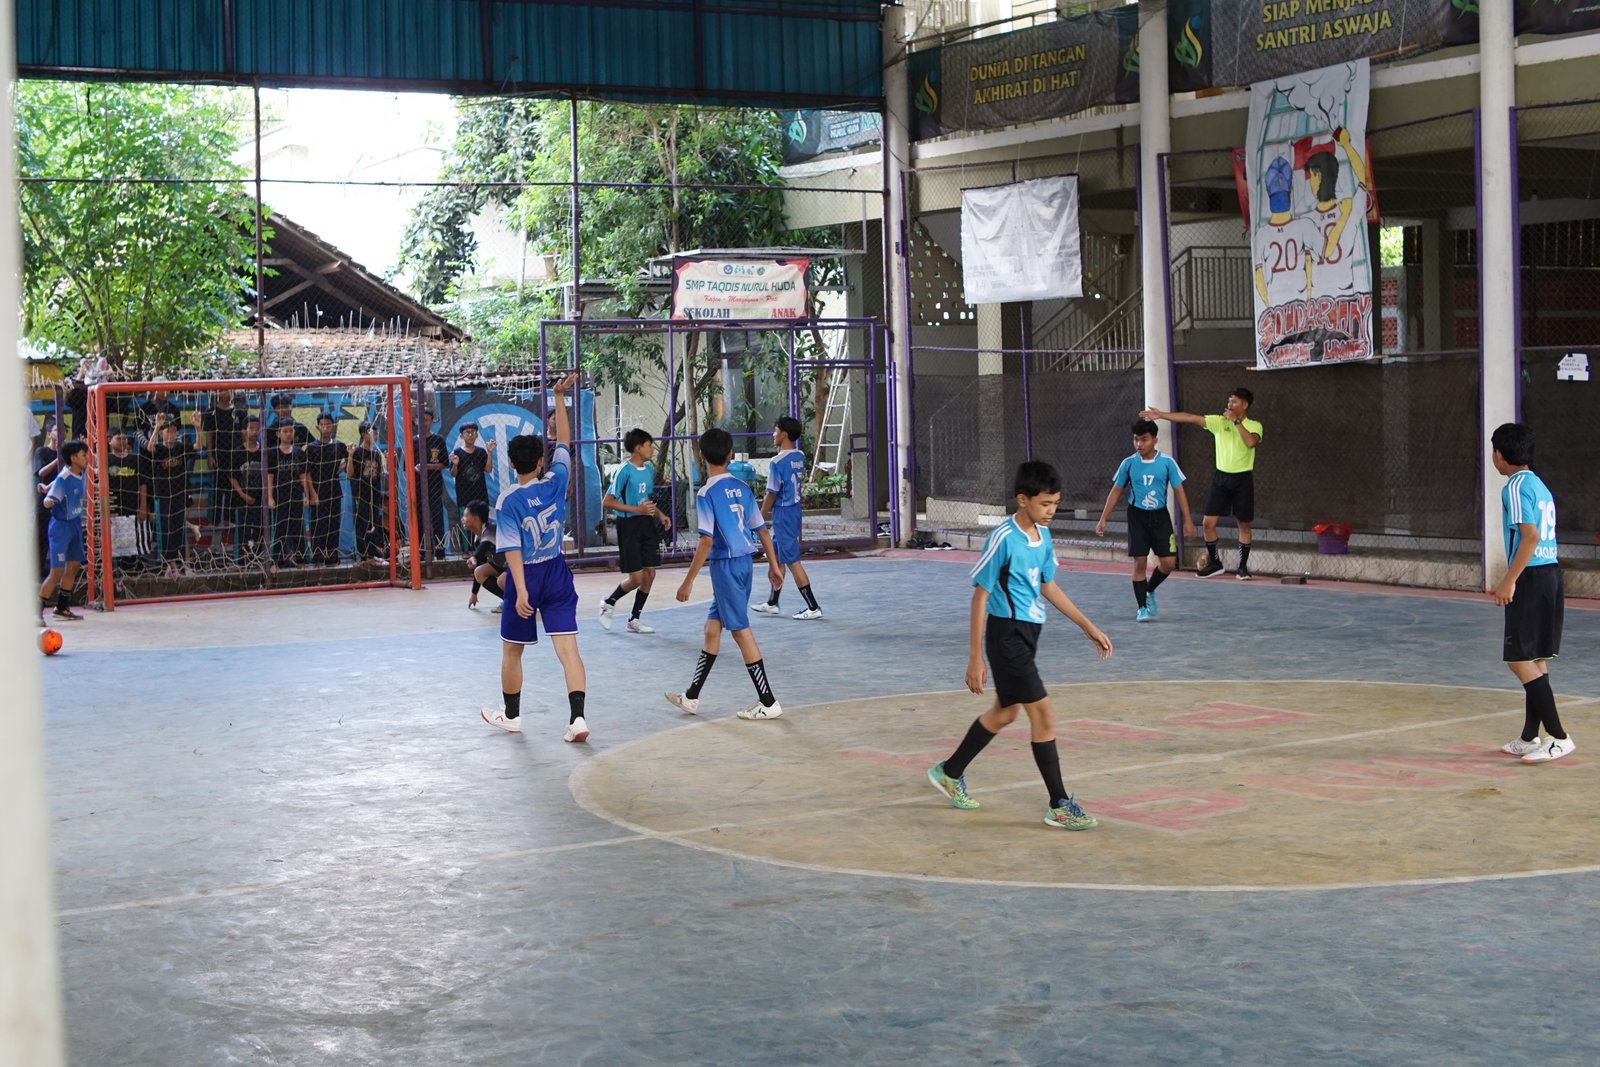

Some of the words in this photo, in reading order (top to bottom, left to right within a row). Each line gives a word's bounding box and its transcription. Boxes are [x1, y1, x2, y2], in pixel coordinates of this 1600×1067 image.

[1256, 24, 1316, 51] SANTRI
[1322, 10, 1392, 40] ASWAJA
[1263, 2, 1300, 23] SIAP
[969, 60, 1010, 82] DUNIA
[1014, 56, 1028, 73] DI
[1032, 44, 1086, 70] TANGAN
[974, 80, 1029, 105] AKHIRAT
[1033, 77, 1046, 94] DI
[1051, 69, 1081, 91] HATI
[1269, 238, 1298, 274] 20
[685, 280, 705, 290] SMP
[708, 281, 740, 292] TAQDIS
[741, 282, 769, 292] NURUL
[771, 281, 796, 291] HUDA
[771, 307, 797, 319] ANAK
[638, 482, 647, 494] 13
[1142, 474, 1155, 486] 17
[521, 503, 560, 556] 15
[1538, 500, 1557, 541] 19
